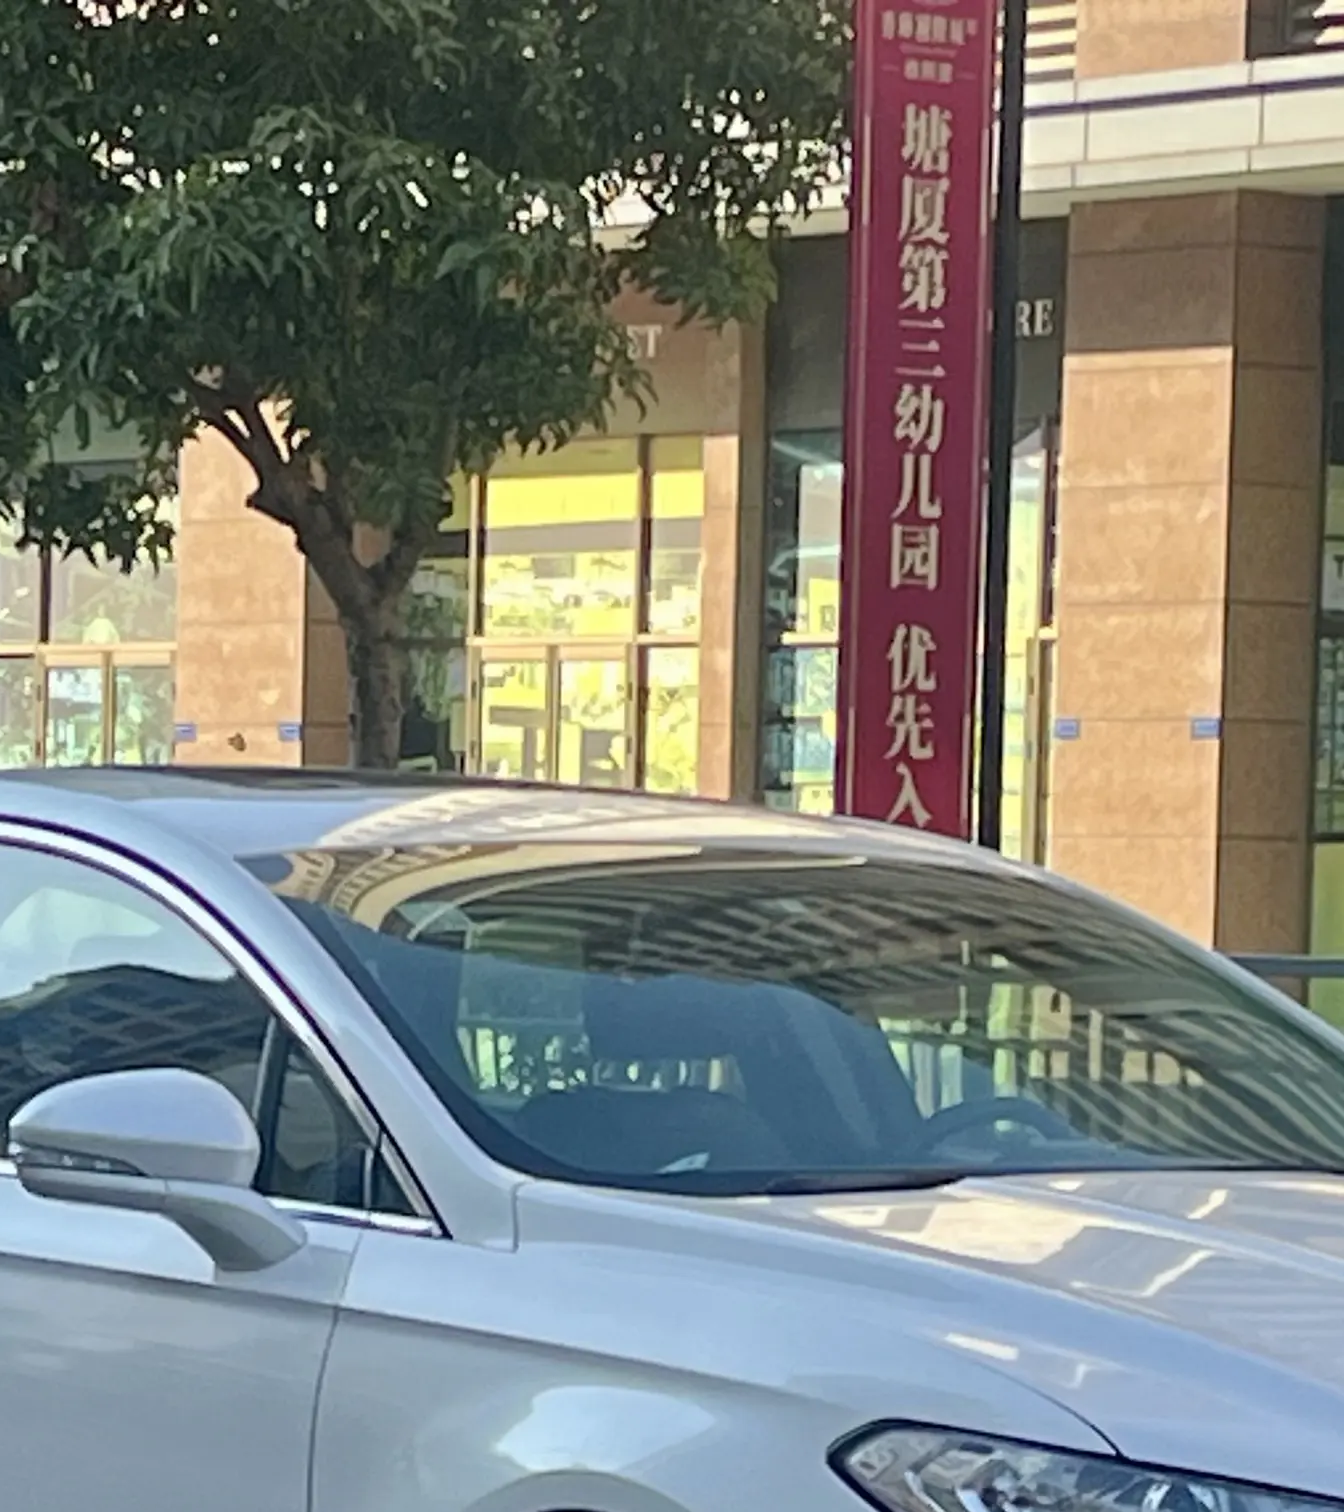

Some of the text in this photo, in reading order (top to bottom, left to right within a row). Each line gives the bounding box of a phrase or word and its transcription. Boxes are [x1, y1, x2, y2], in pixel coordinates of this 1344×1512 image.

[889, 102, 953, 591] 塘厦第三幼儿园
